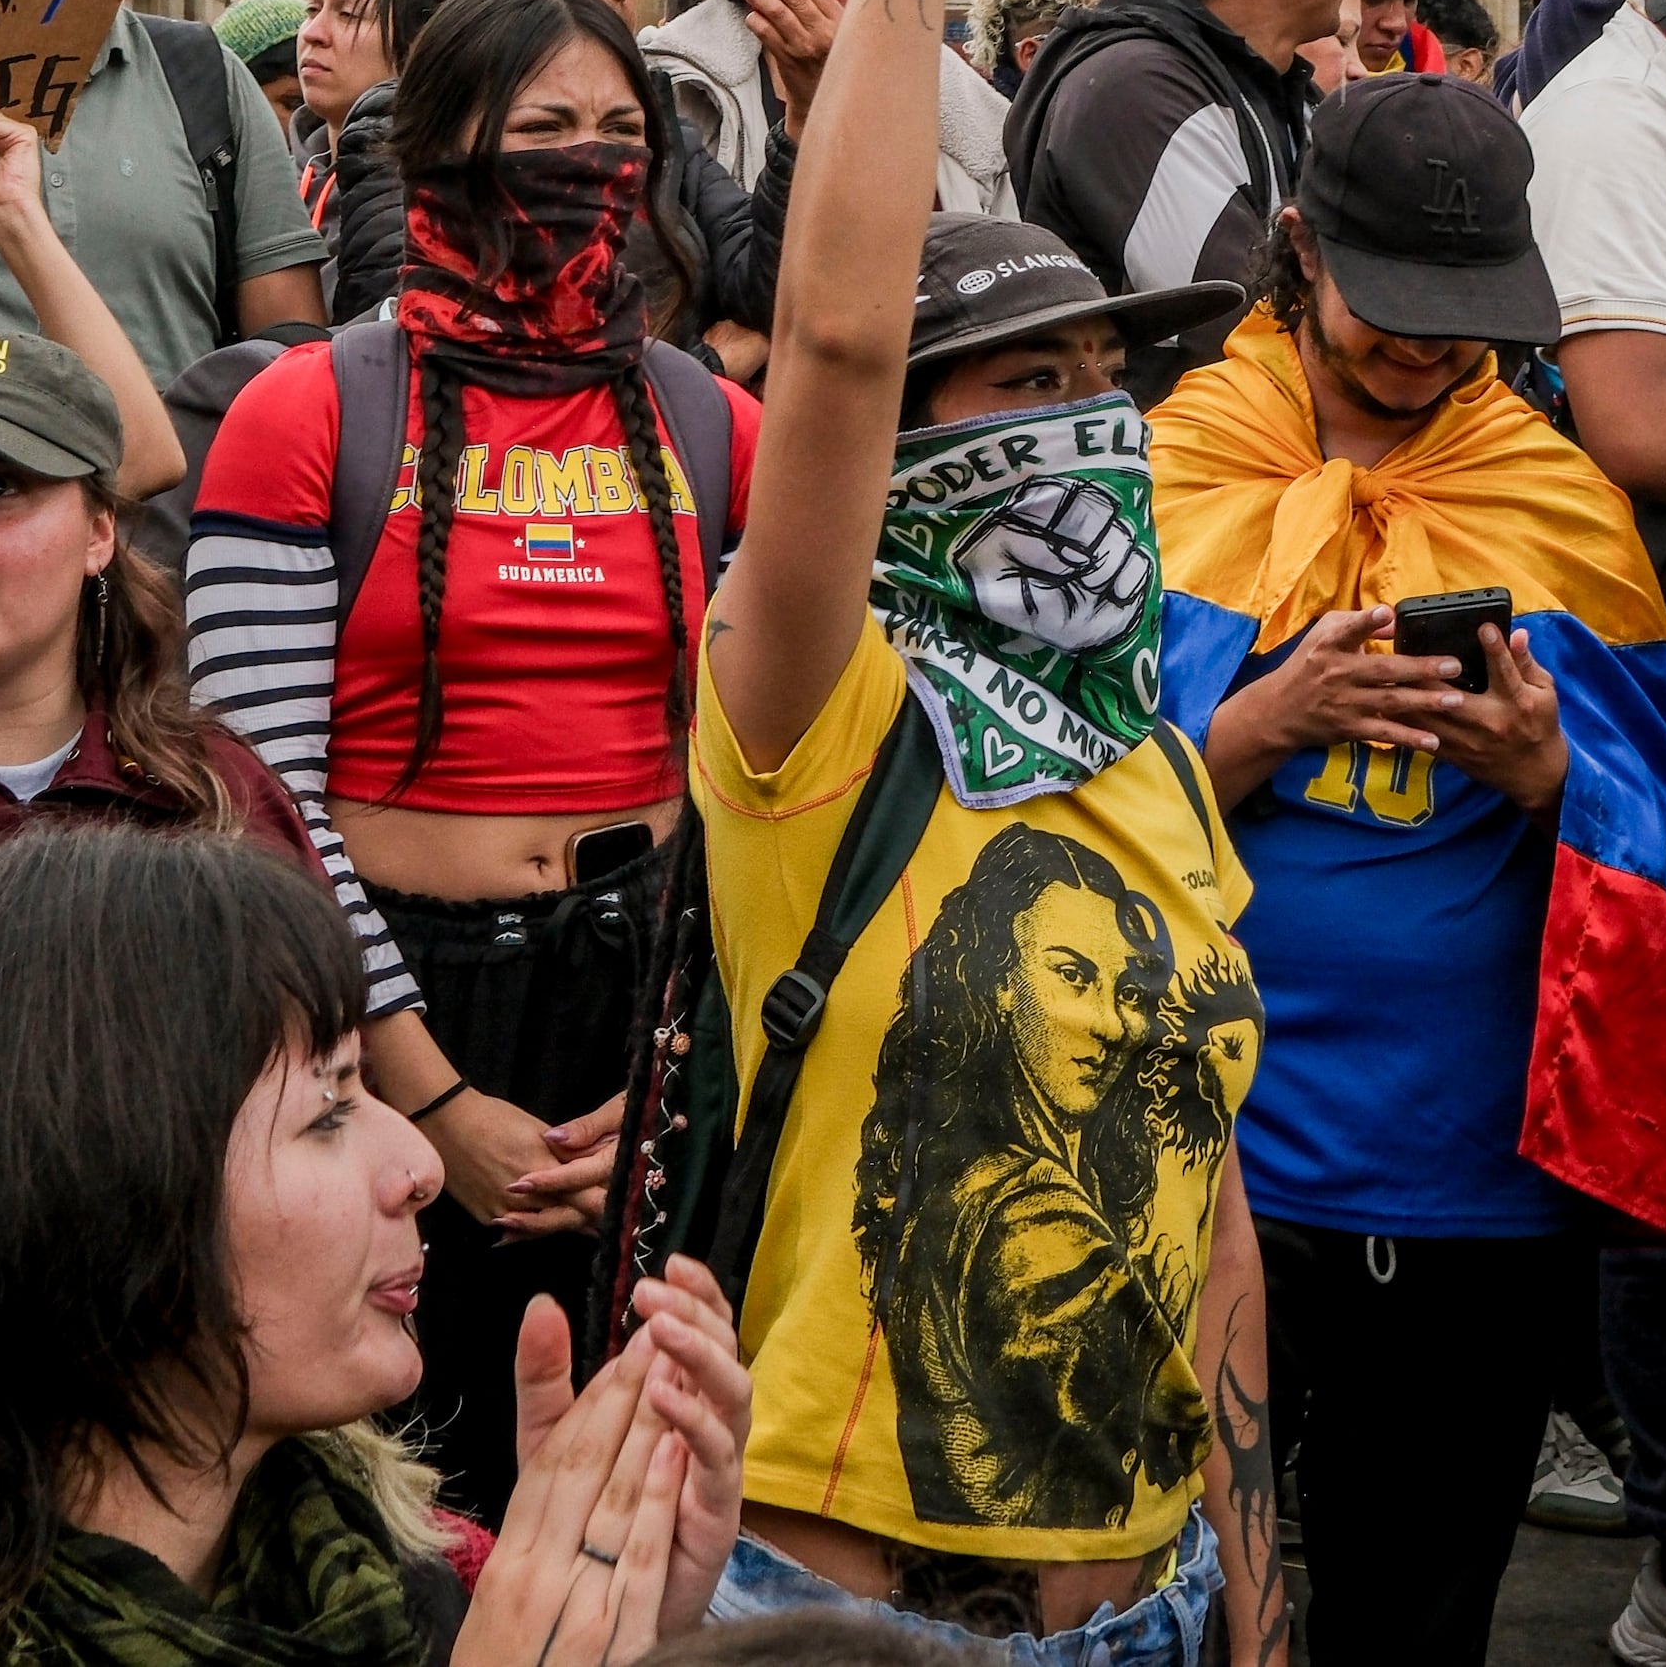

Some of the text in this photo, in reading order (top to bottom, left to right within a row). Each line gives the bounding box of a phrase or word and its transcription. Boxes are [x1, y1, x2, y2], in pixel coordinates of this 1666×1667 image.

[1421, 158, 1481, 233] LA
[388, 443, 697, 517] CLOMBIA
[886, 434, 1045, 511] PODER
[497, 564, 605, 584] SUDAMERICA
[986, 667, 1048, 725] NO
[1057, 711, 1123, 768] MOR
